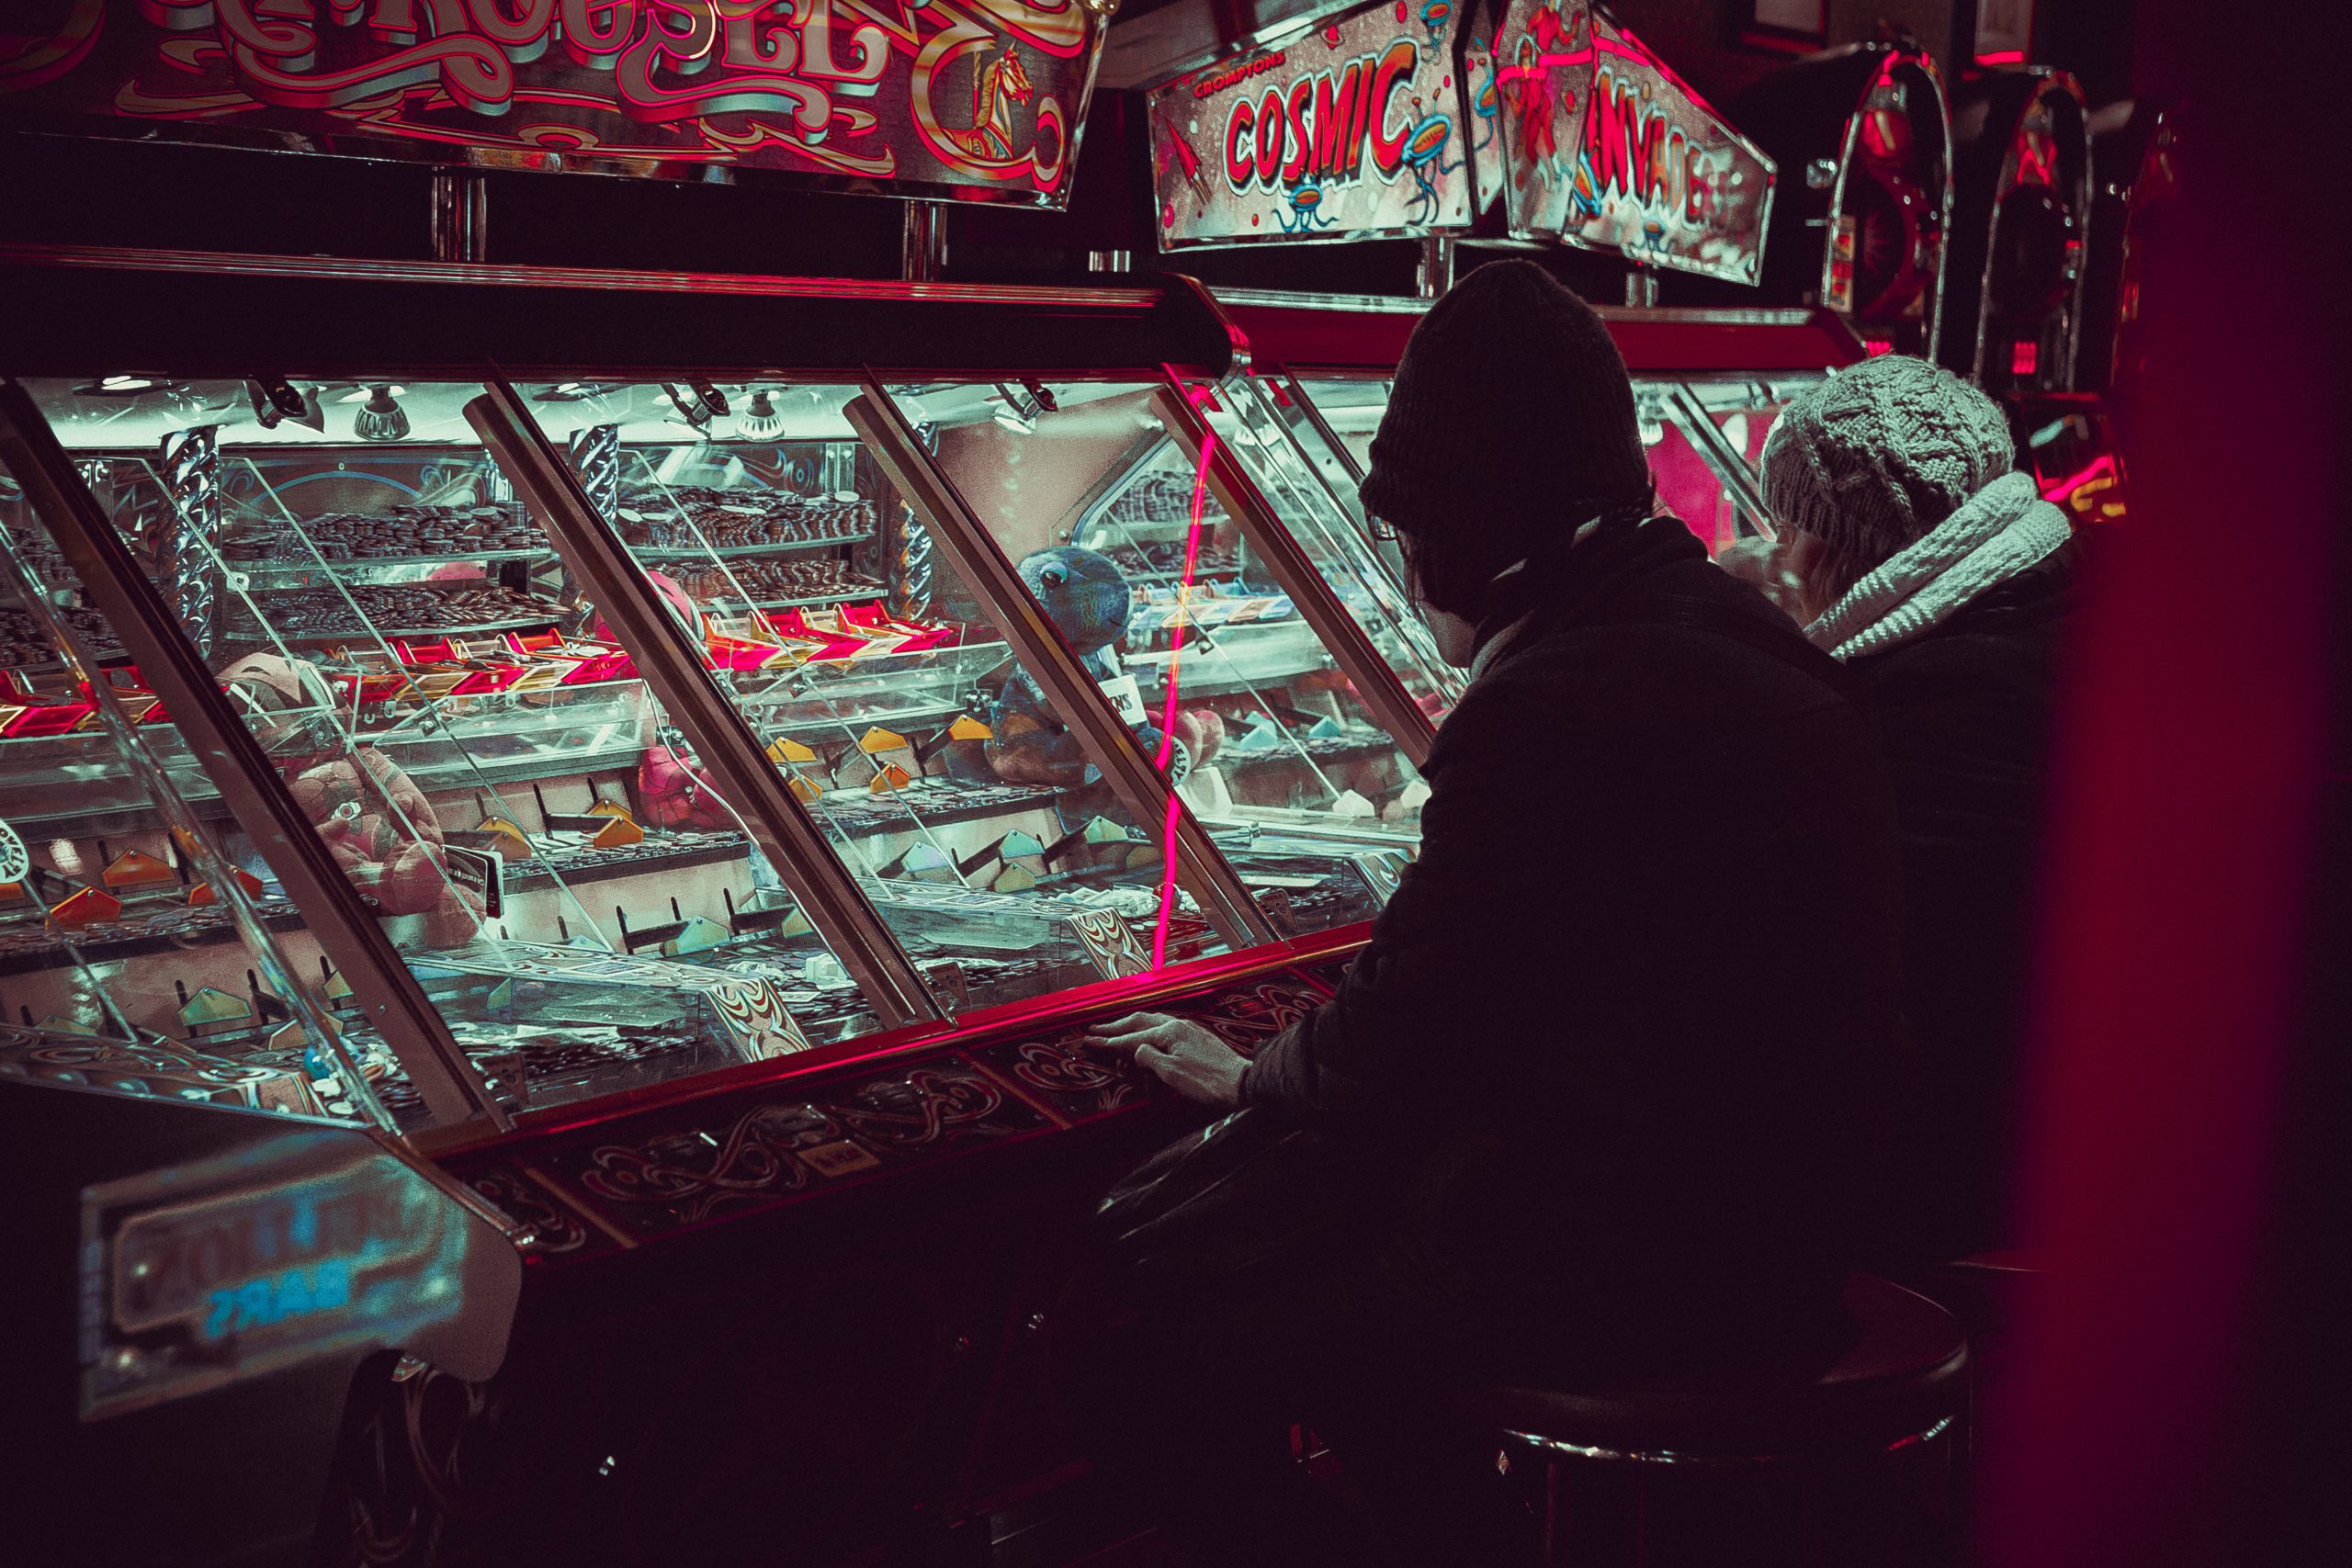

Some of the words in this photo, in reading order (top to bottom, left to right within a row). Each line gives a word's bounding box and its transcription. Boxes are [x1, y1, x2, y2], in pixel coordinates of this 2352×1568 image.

[140, 0, 889, 144] OUSEL
[1194, 51, 1285, 98] CROMPTONS
[1224, 37, 1421, 193] COSMIC
[1586, 66, 1731, 227] INVADE
